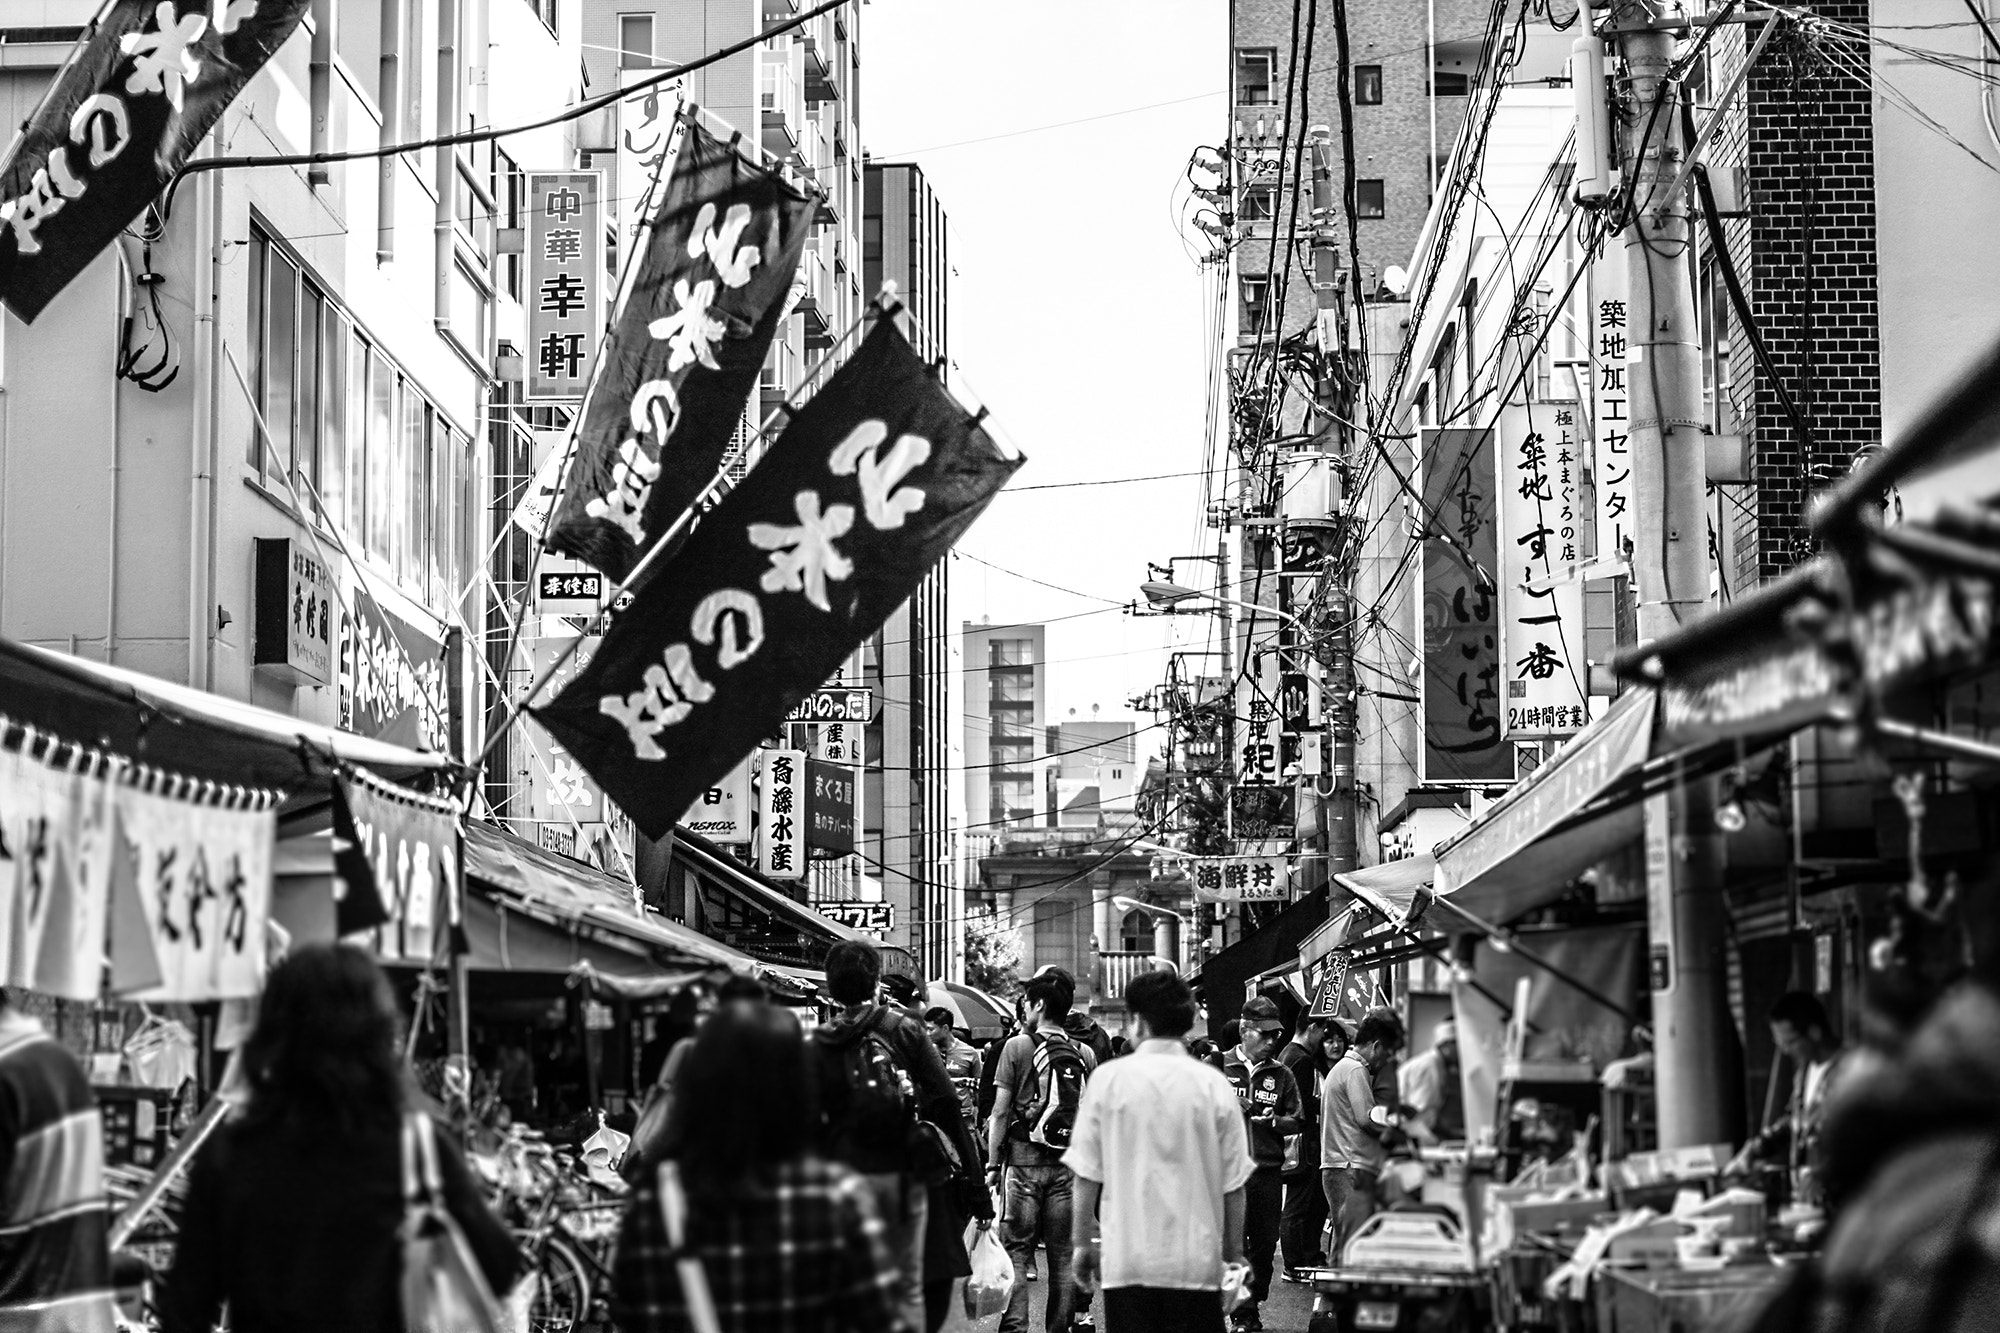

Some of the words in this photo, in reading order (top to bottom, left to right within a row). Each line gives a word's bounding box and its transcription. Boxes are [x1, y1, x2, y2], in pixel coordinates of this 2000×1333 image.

[540, 187, 585, 379] 中華幸軒
[1555, 410, 1575, 561] 極上本まぐろの店
[1599, 300, 1630, 549] 築地加工センター
[1509, 705, 1583, 730] 24時間営業
[1198, 863, 1275, 889] 海鮮丼
